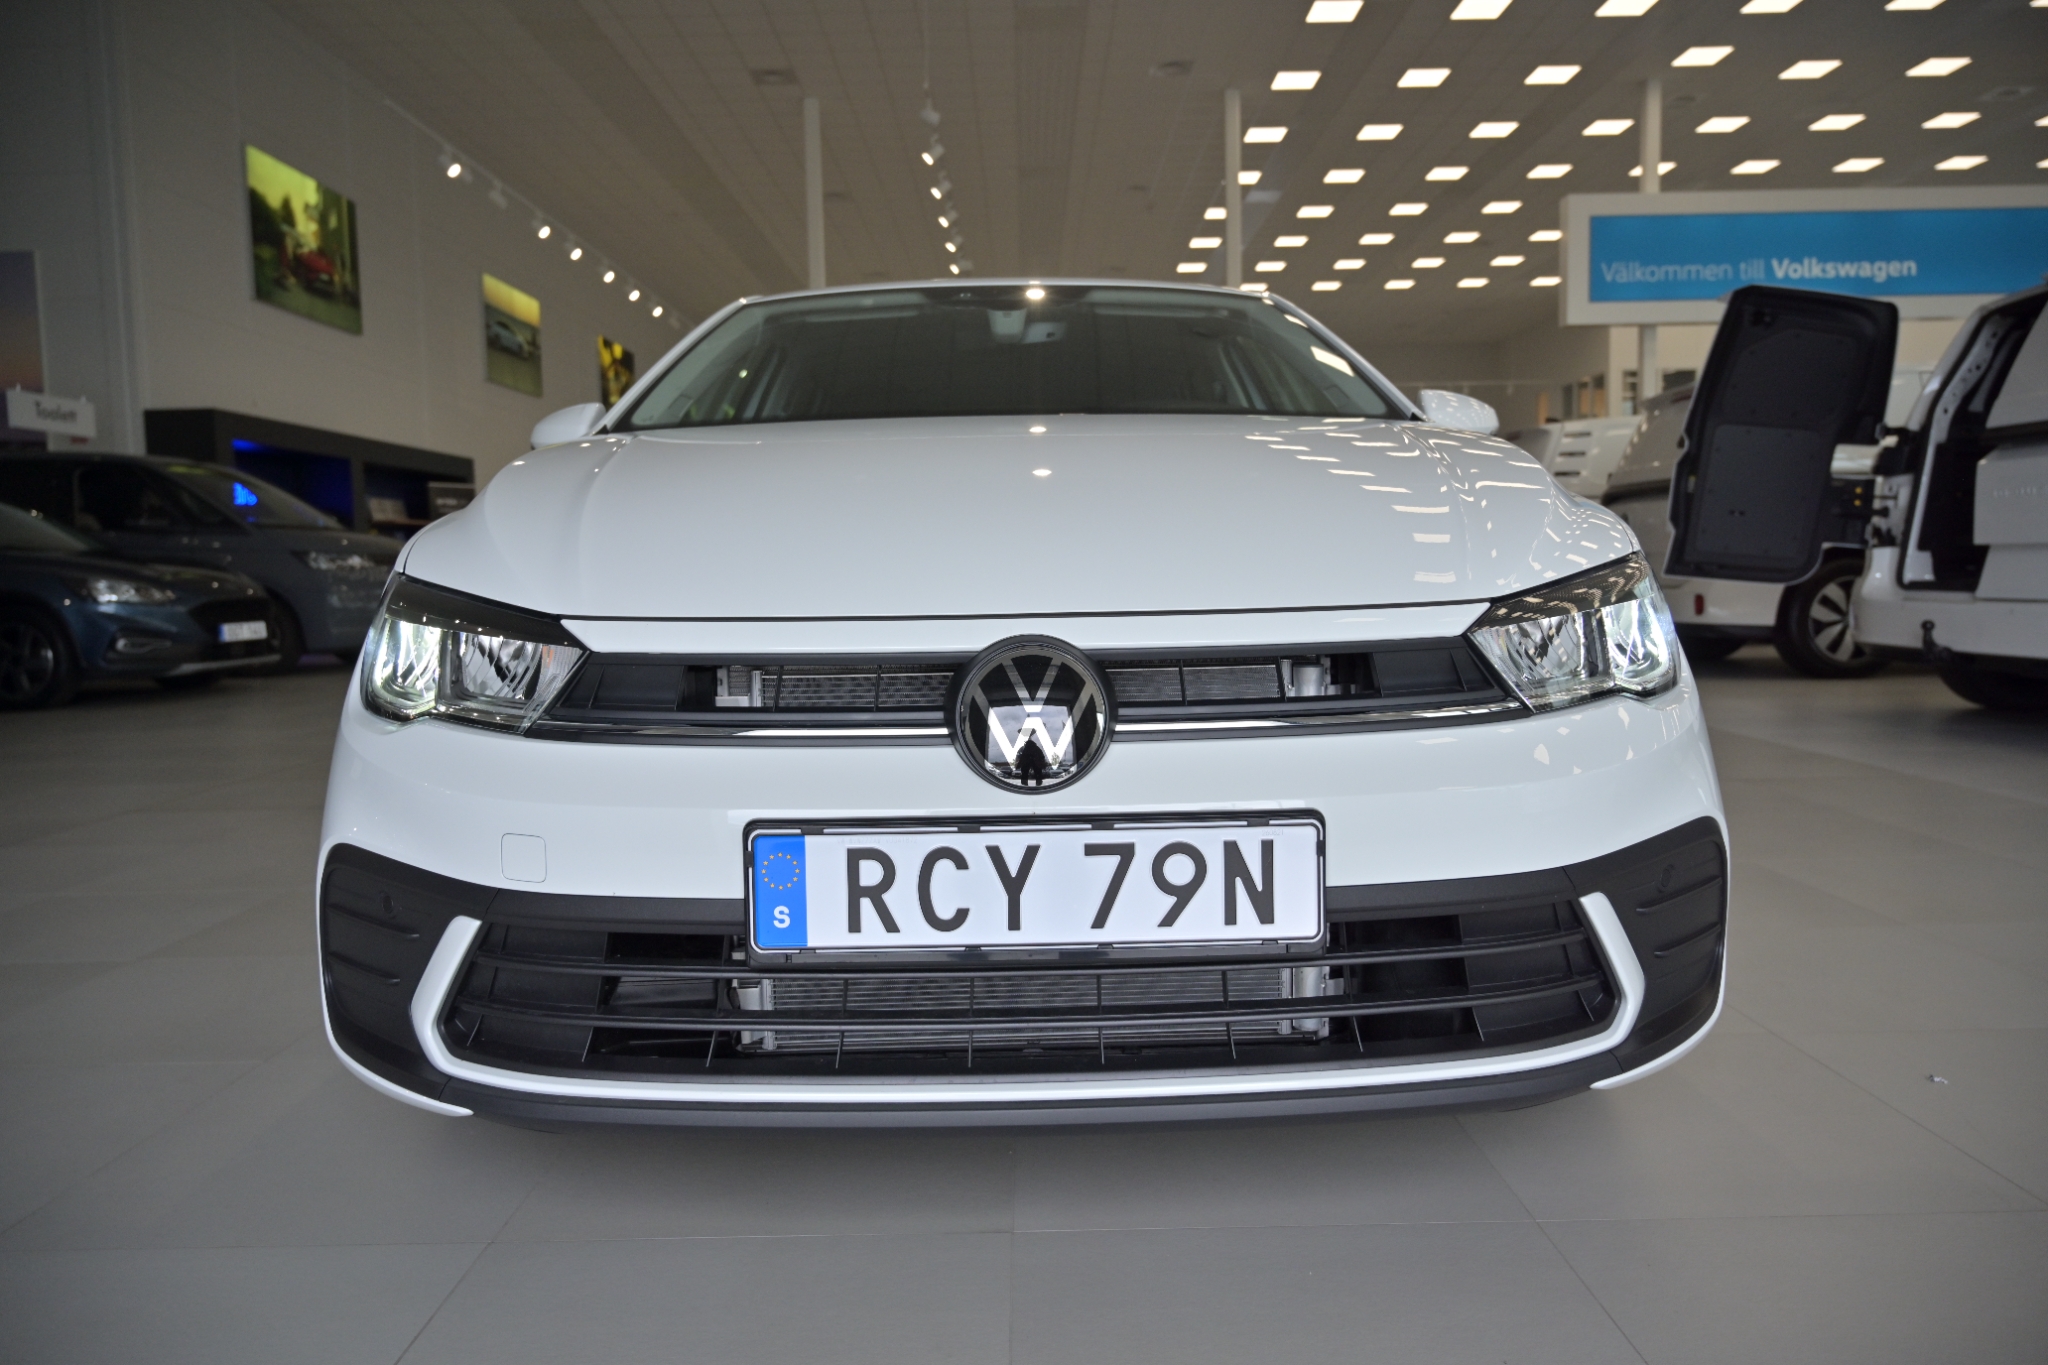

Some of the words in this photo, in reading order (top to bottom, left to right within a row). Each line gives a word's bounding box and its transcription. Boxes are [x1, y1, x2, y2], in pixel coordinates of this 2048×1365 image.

[1601, 261, 1733, 283] Välkommen
[1739, 260, 1766, 281] till
[1771, 256, 1917, 283] Volkswagen
[846, 844, 1040, 933] RCY
[1084, 839, 1275, 929] 79N
[773, 905, 791, 929] S
